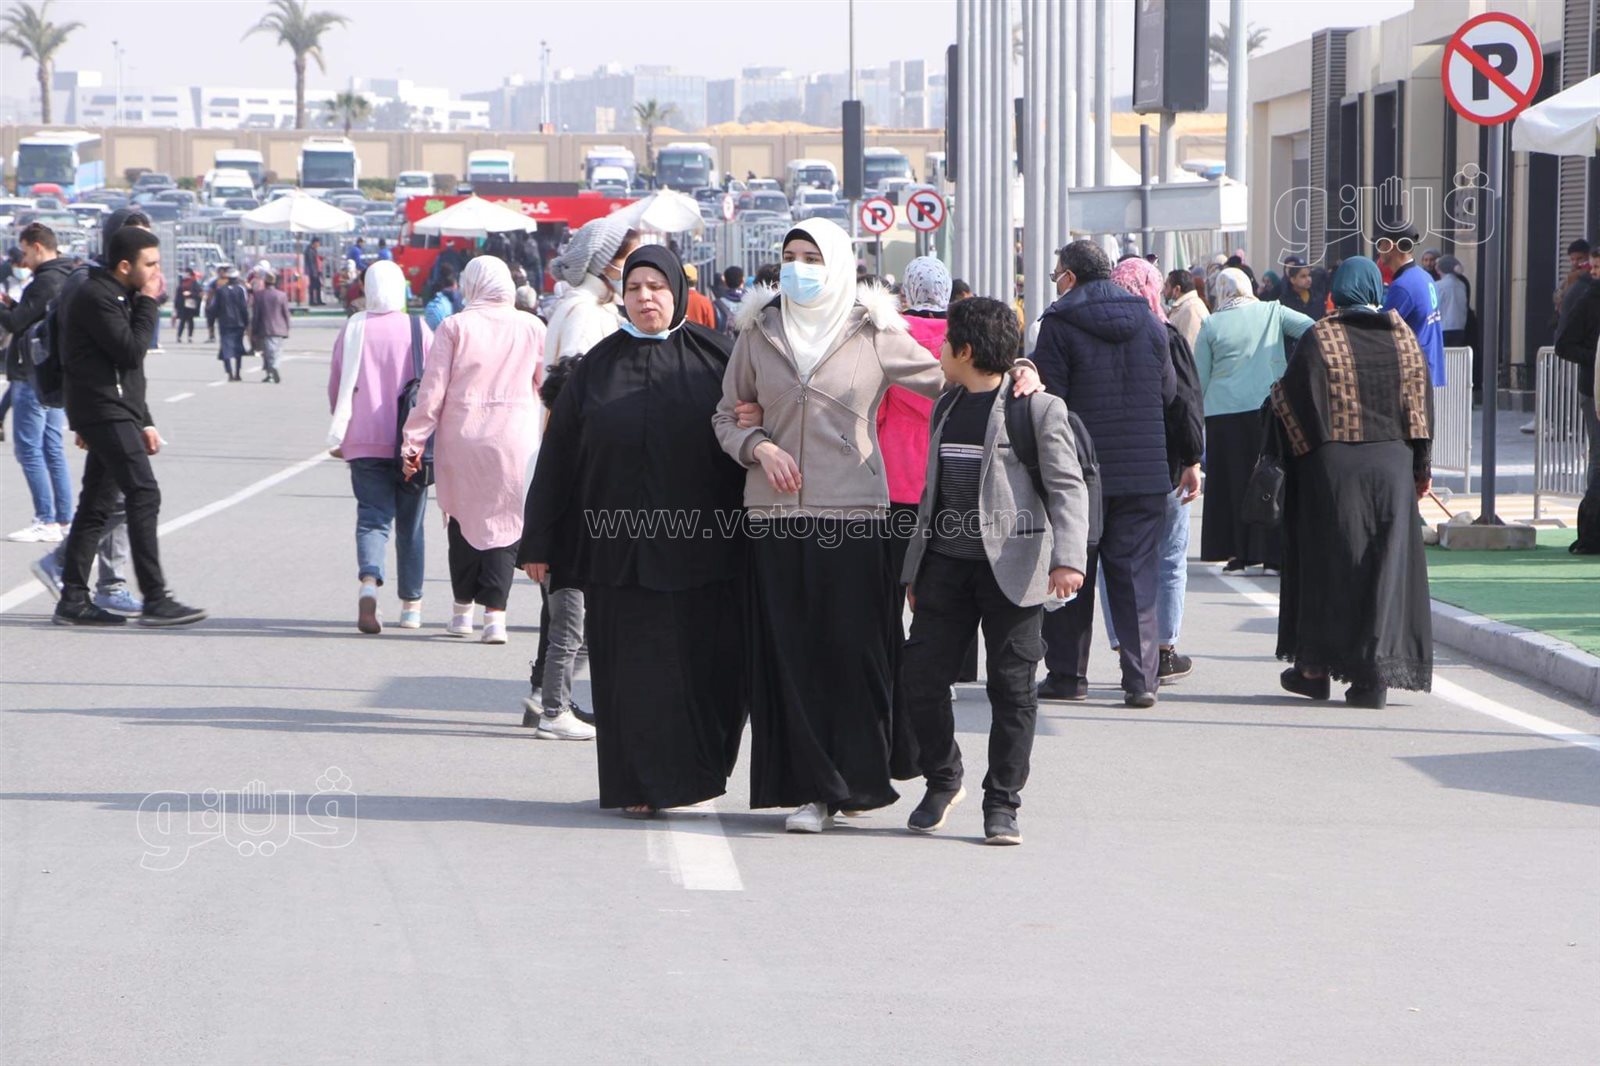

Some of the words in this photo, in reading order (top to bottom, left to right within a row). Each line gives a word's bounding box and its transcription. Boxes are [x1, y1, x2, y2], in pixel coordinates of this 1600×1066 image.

[1472, 42, 1518, 101] P
[871, 208, 886, 225] P
[917, 201, 936, 222] P
